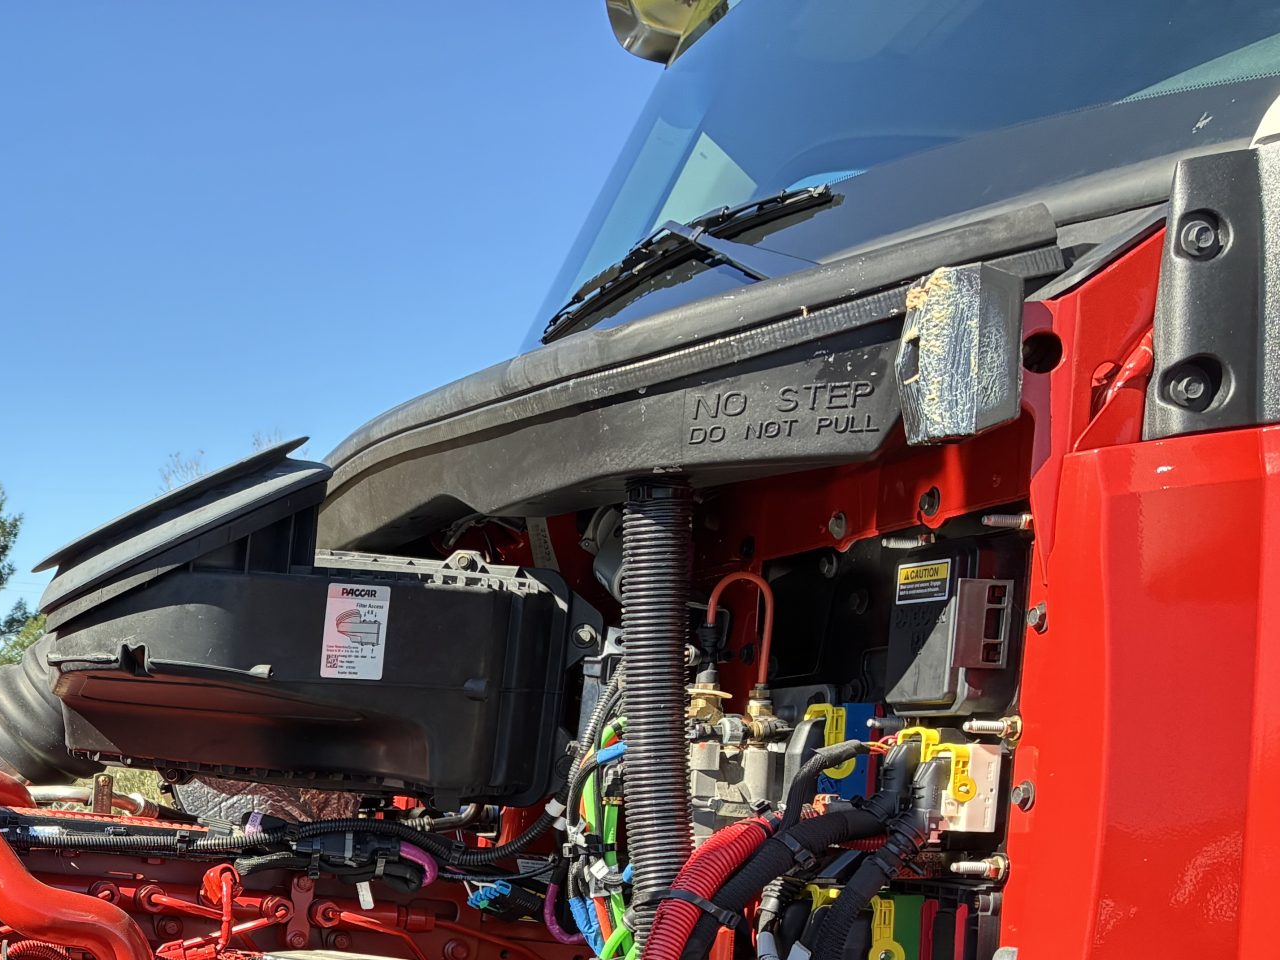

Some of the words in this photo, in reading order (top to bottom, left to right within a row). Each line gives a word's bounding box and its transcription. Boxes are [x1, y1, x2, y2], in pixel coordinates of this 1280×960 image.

[692, 393, 747, 420] NO
[774, 381, 875, 413] STEP
[688, 425, 726, 445] DO
[744, 419, 799, 440] NOT
[816, 414, 880, 434] PULL
[910, 566, 940, 580] CAUTION
[341, 588, 377, 598] PACCAR
